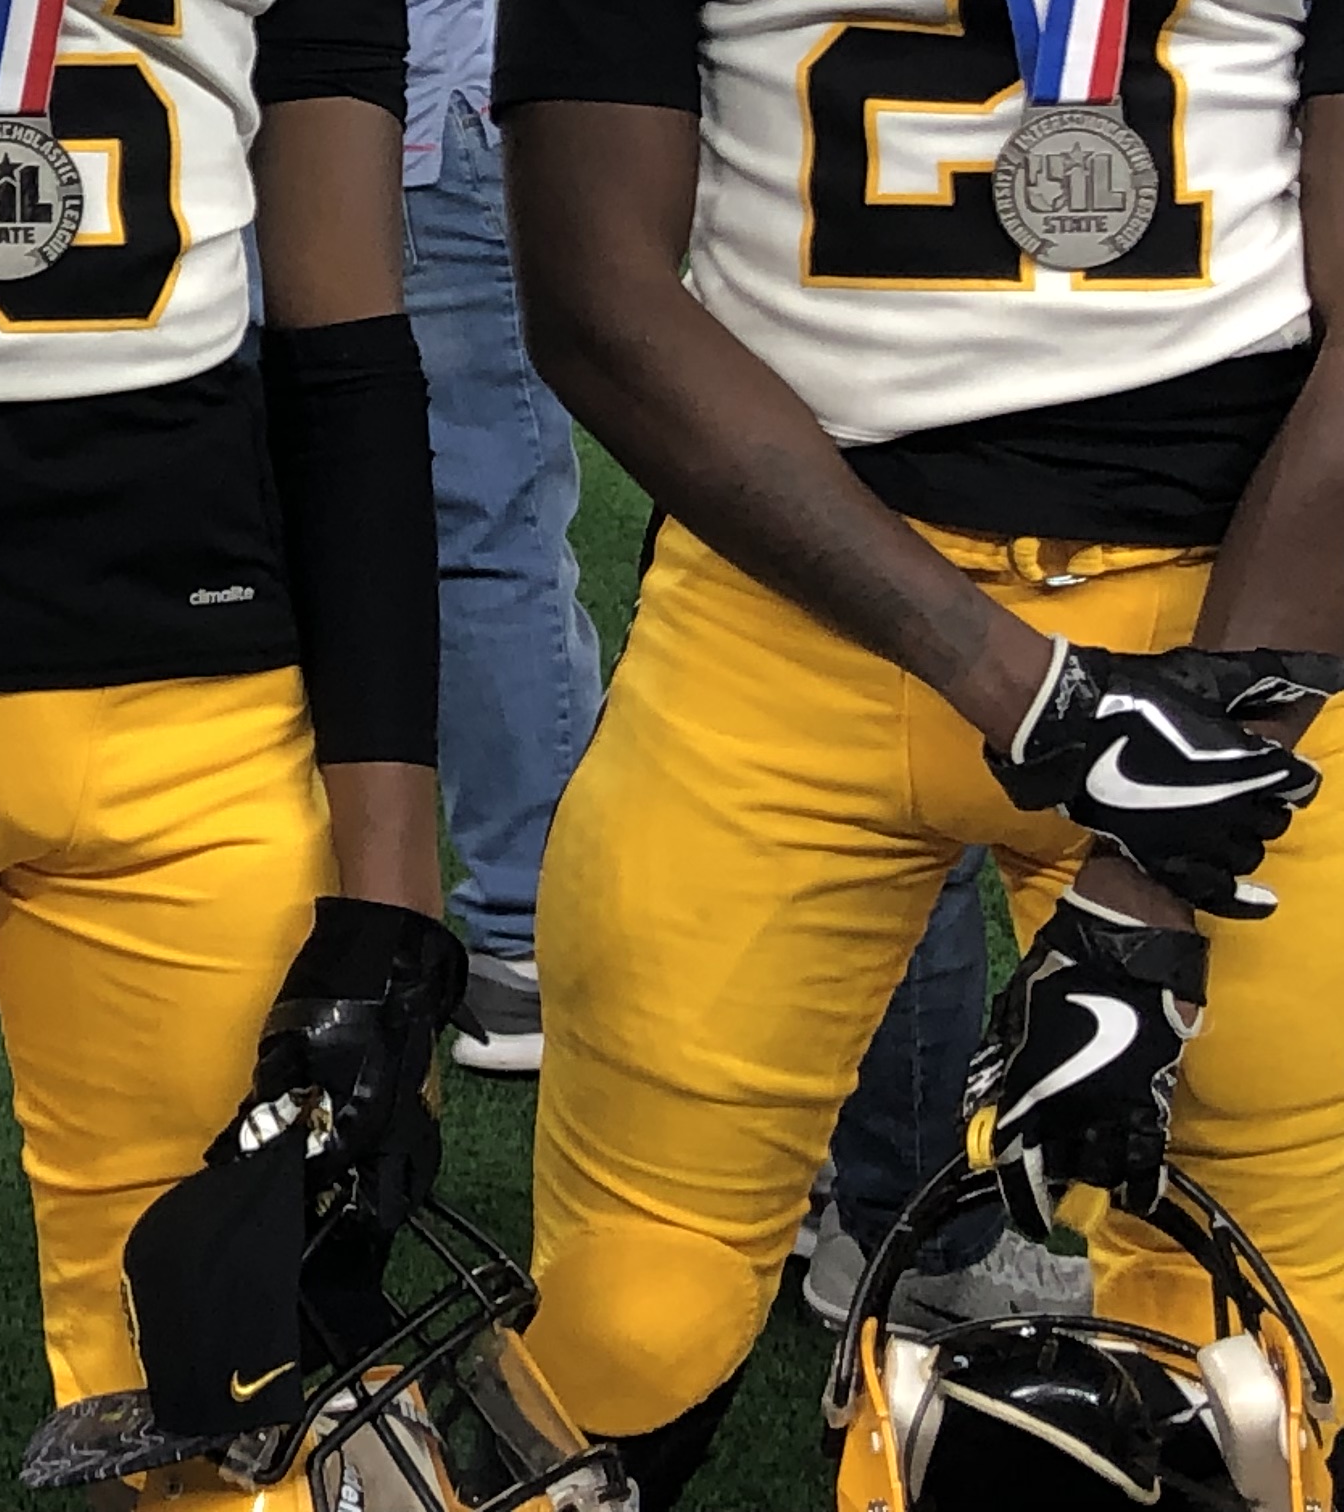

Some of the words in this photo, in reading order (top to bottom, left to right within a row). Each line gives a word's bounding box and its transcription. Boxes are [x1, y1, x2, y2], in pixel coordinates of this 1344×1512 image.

[1023, 142, 1127, 214] UIL
[41, 195, 84, 263] LEAGUE
[1041, 214, 1109, 234] STATE
